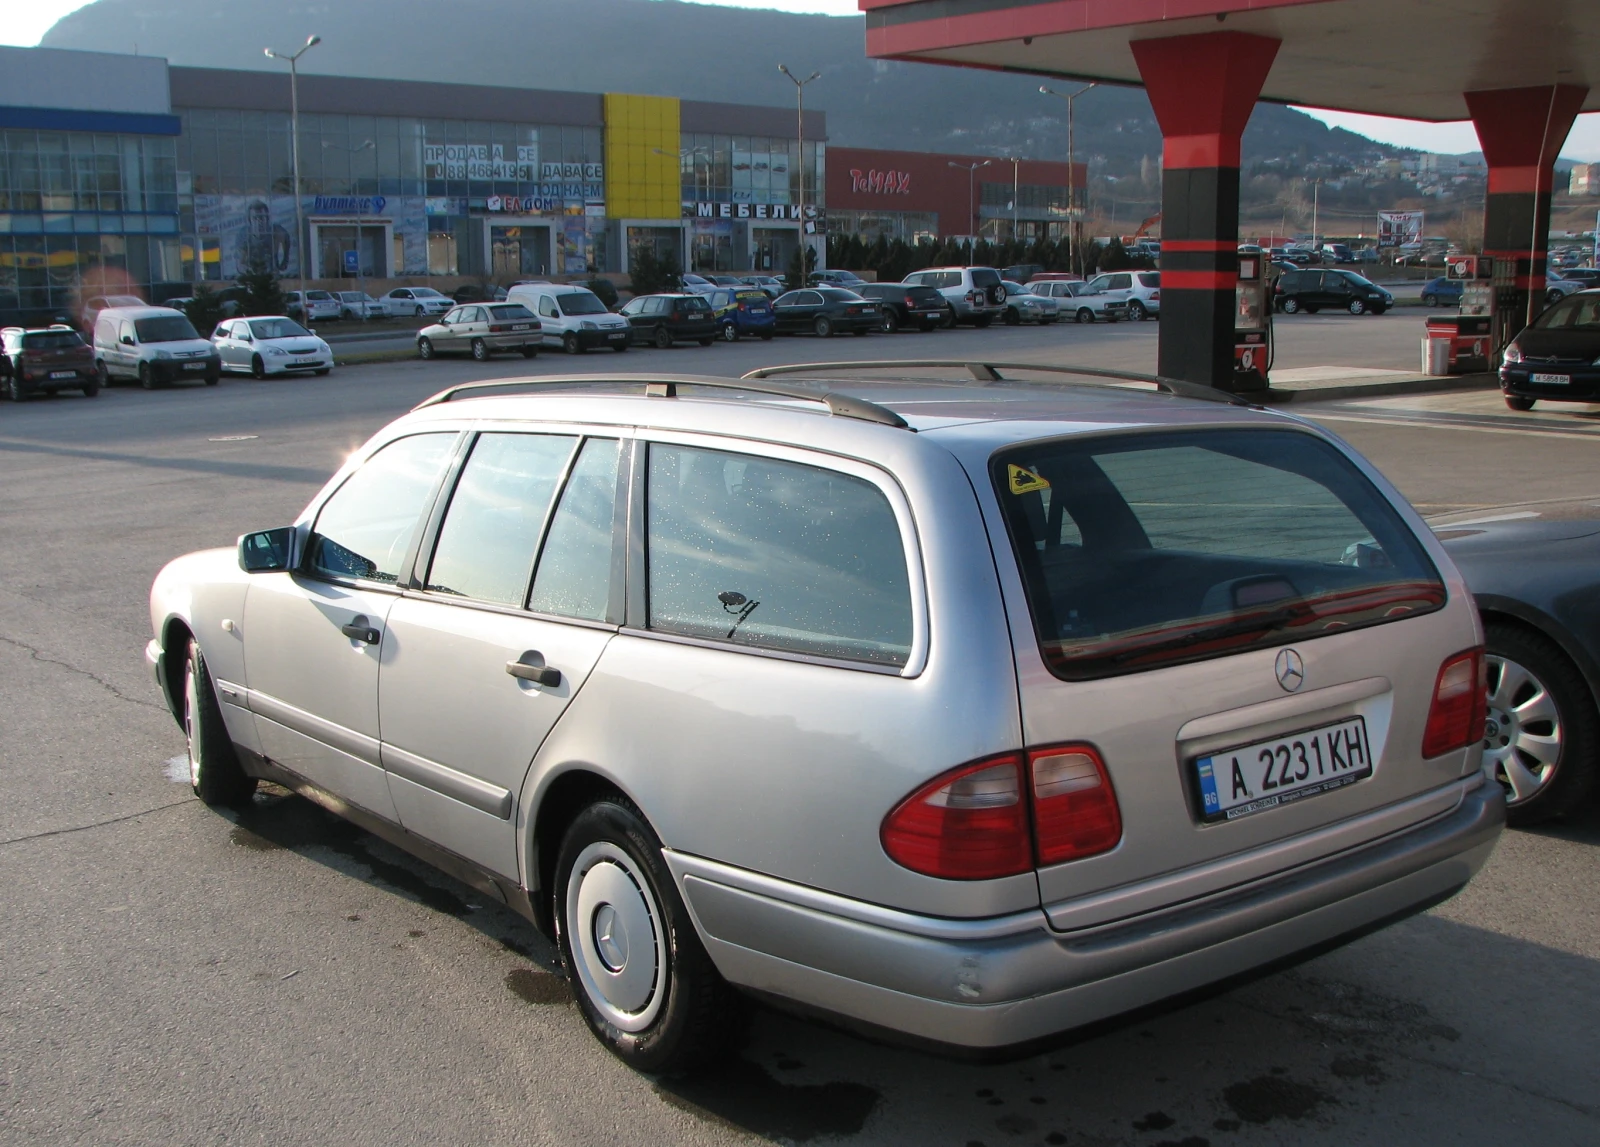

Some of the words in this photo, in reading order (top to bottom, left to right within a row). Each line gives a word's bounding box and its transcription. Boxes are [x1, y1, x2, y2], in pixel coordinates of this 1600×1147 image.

[517, 148, 535, 161] СЕ
[697, 203, 801, 218] МЕБЕЛИ
[1231, 757, 1248, 800] A
[1204, 792, 1218, 805] BG
[1228, 805, 1250, 818] MICHAEL
[1250, 797, 1277, 811] SCHREINER
